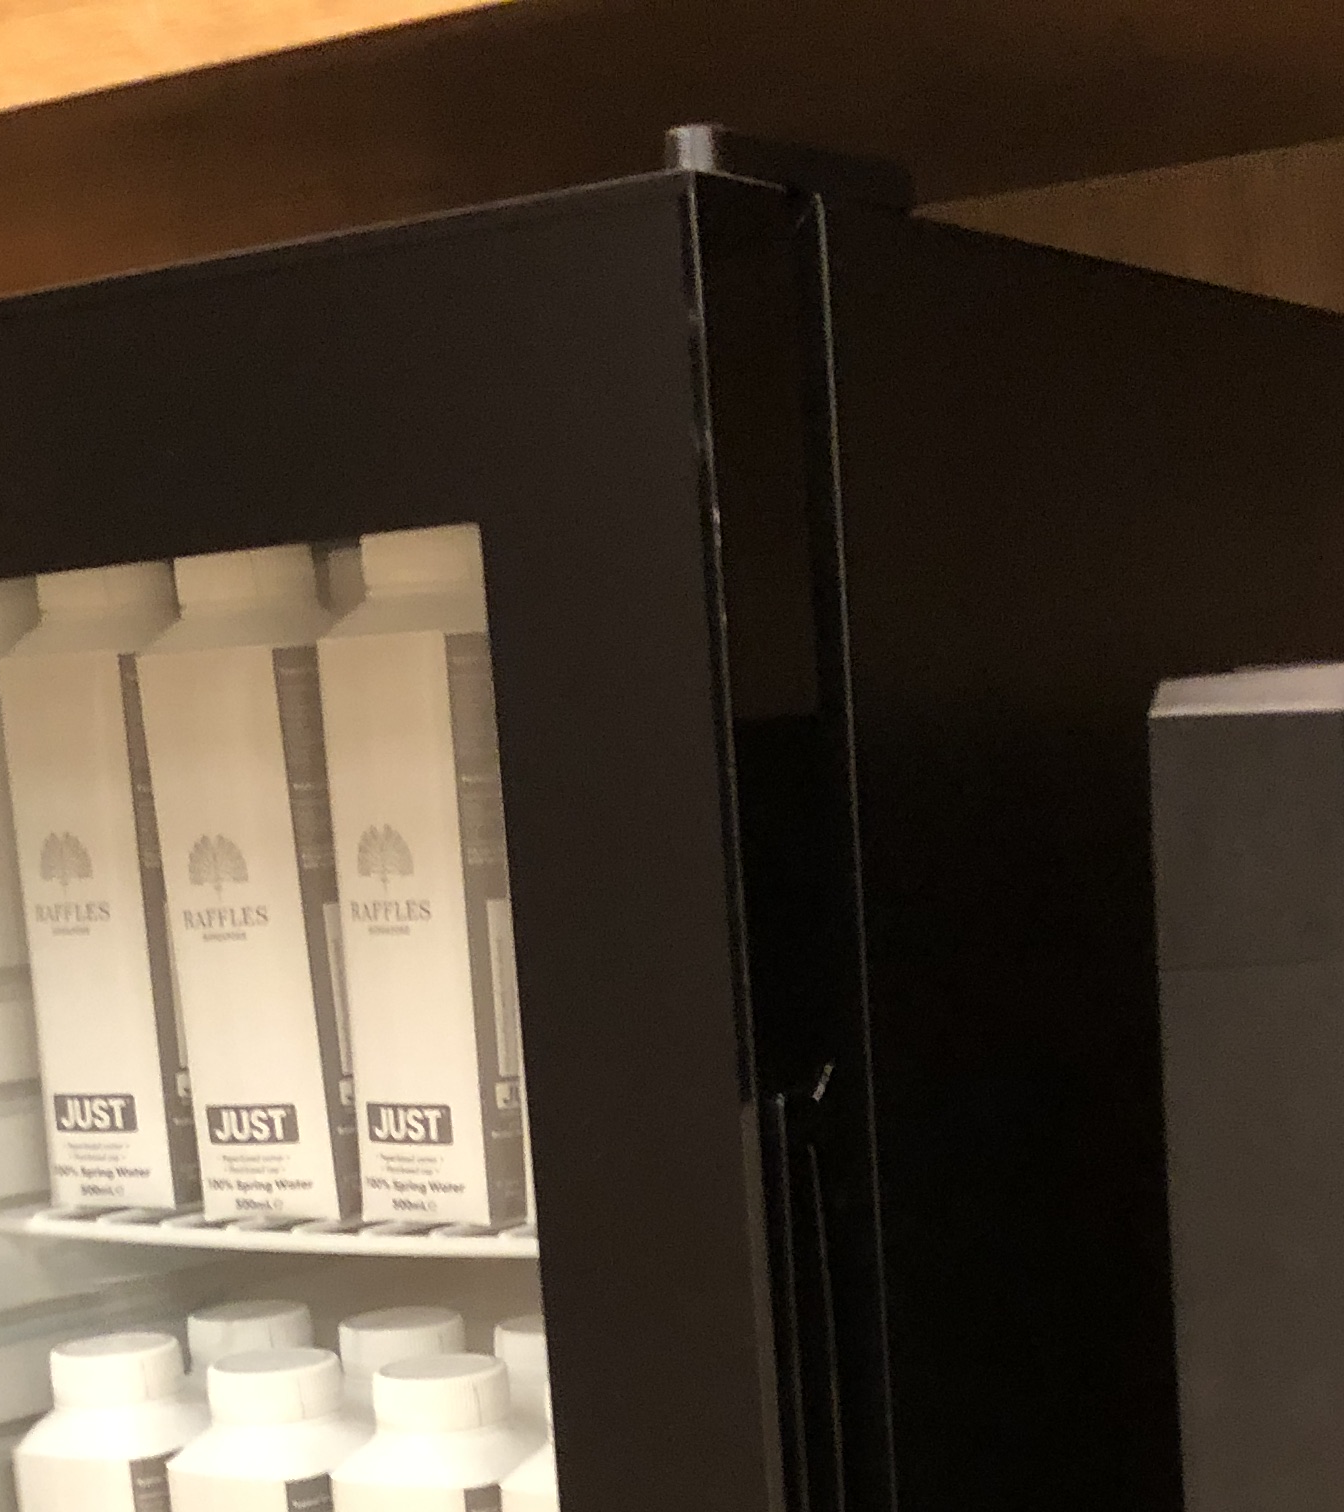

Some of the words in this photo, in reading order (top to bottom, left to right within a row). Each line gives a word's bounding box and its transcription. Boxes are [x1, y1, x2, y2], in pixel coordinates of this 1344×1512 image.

[35, 901, 110, 922] RAFFLES
[183, 905, 268, 929] RAFFLES
[351, 900, 432, 921] RAFFLES
[60, 1097, 127, 1130] JUST
[213, 1108, 287, 1142] JUST
[374, 1106, 442, 1142] JUST
